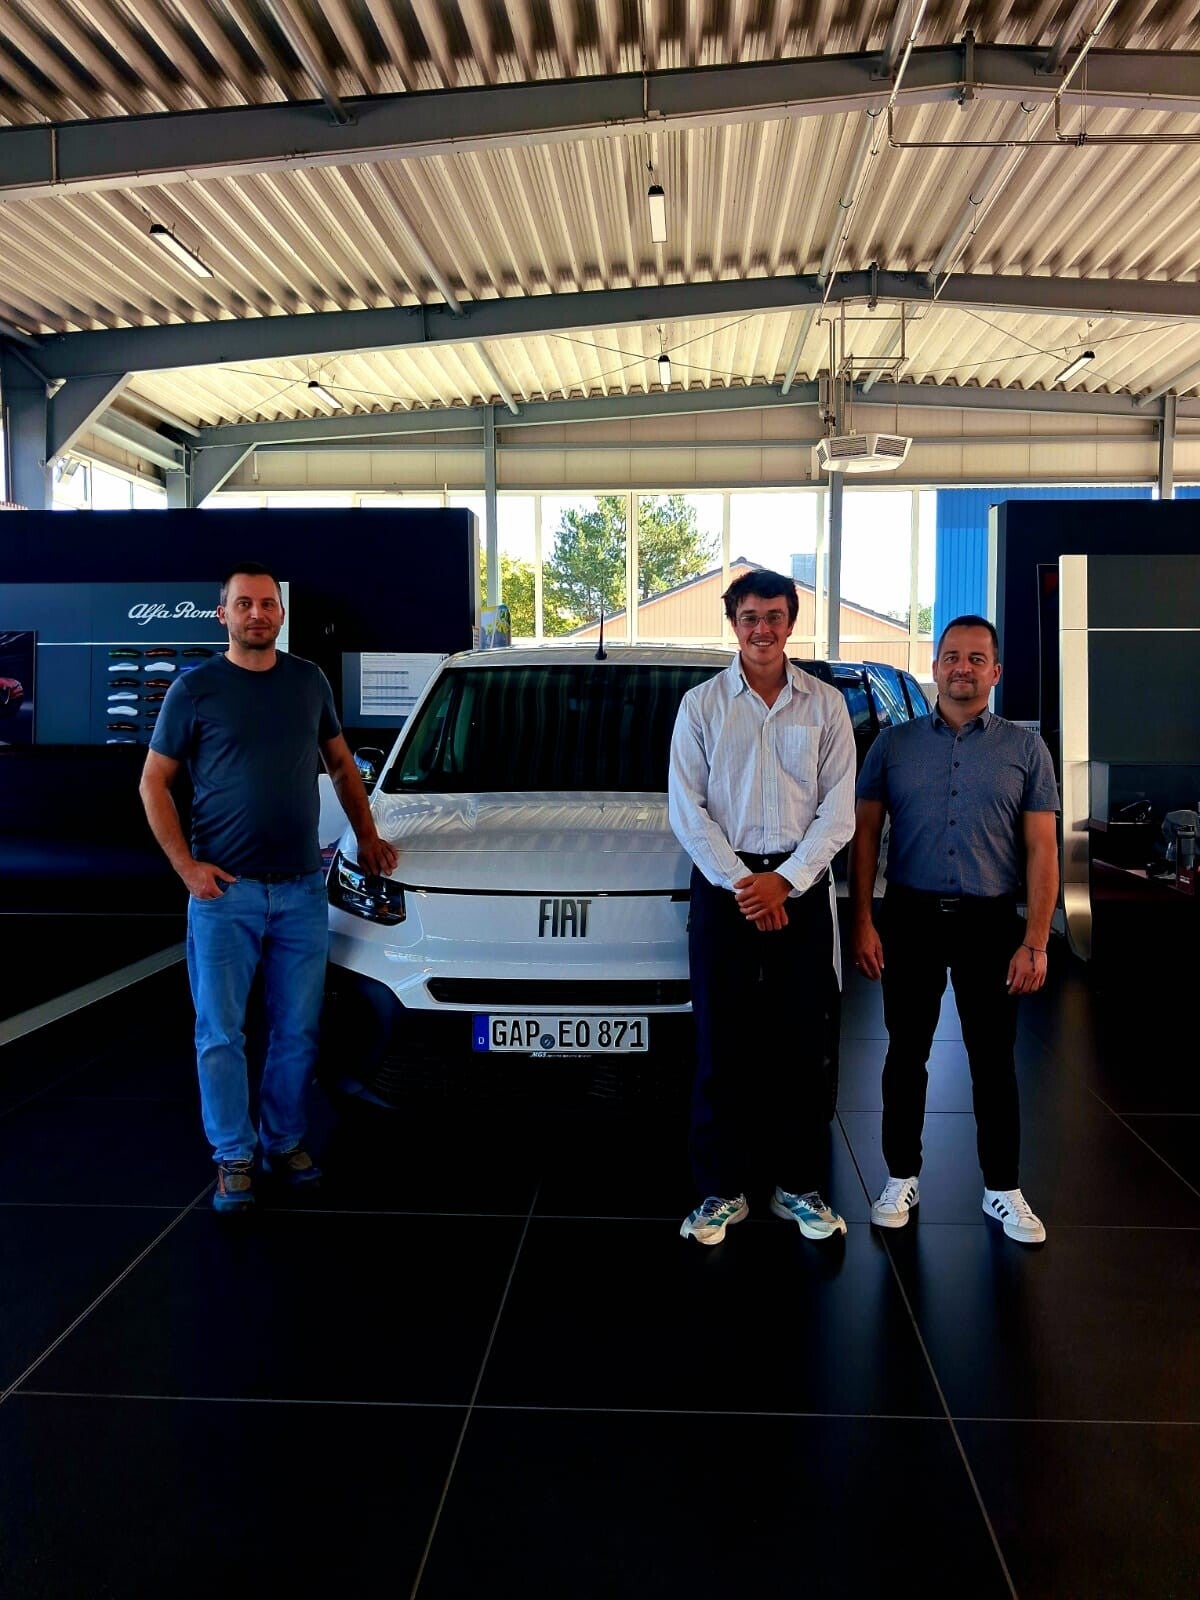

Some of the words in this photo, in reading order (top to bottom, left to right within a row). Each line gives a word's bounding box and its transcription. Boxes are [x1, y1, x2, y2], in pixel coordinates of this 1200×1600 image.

[128, 604, 172, 625] Alfa
[173, 601, 218, 618] Rom
[538, 899, 592, 938] FIAT
[492, 1019, 540, 1047] GAP
[558, 1020, 590, 1048] EO
[598, 1020, 644, 1048] 871
